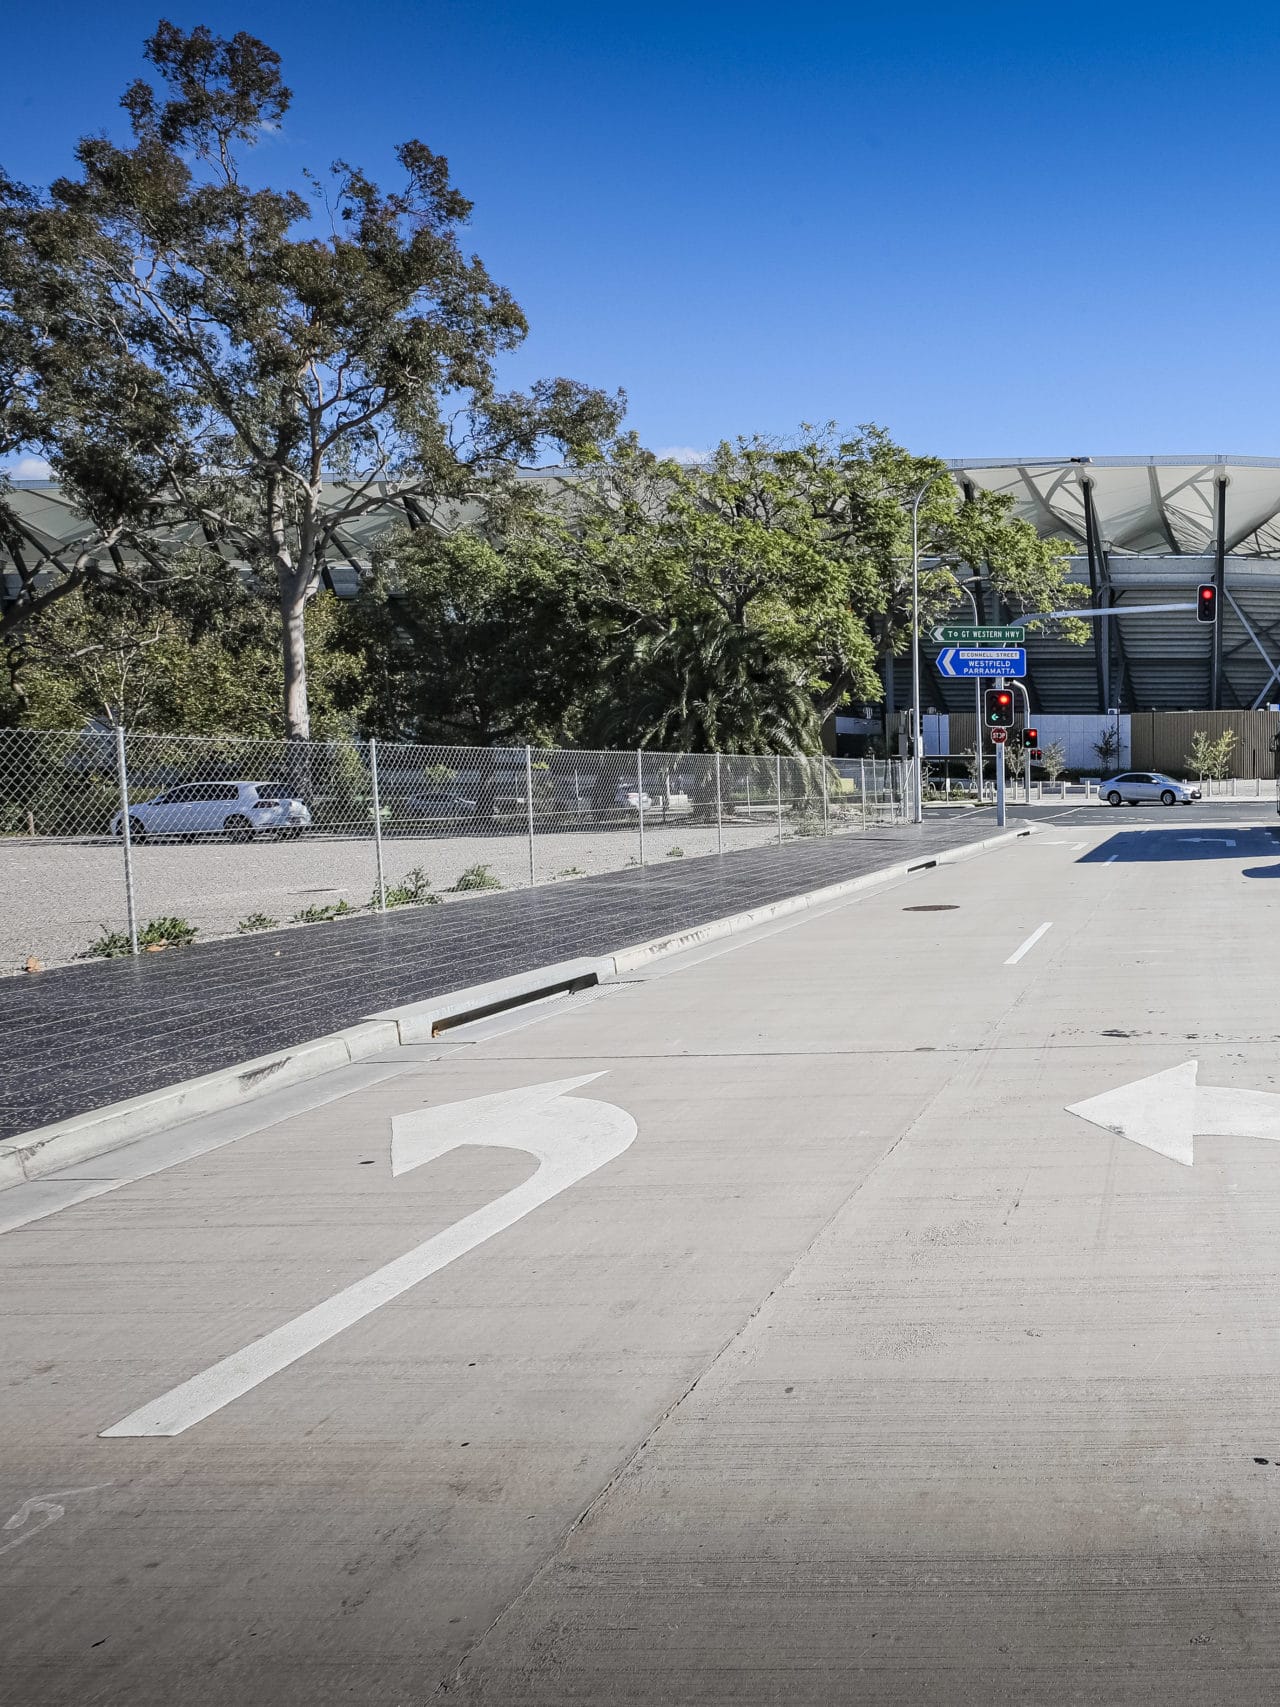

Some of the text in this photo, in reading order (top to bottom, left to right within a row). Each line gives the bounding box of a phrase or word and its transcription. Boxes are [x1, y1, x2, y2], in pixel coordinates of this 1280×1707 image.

[947, 630, 1020, 638] To GT WESTERN HWY
